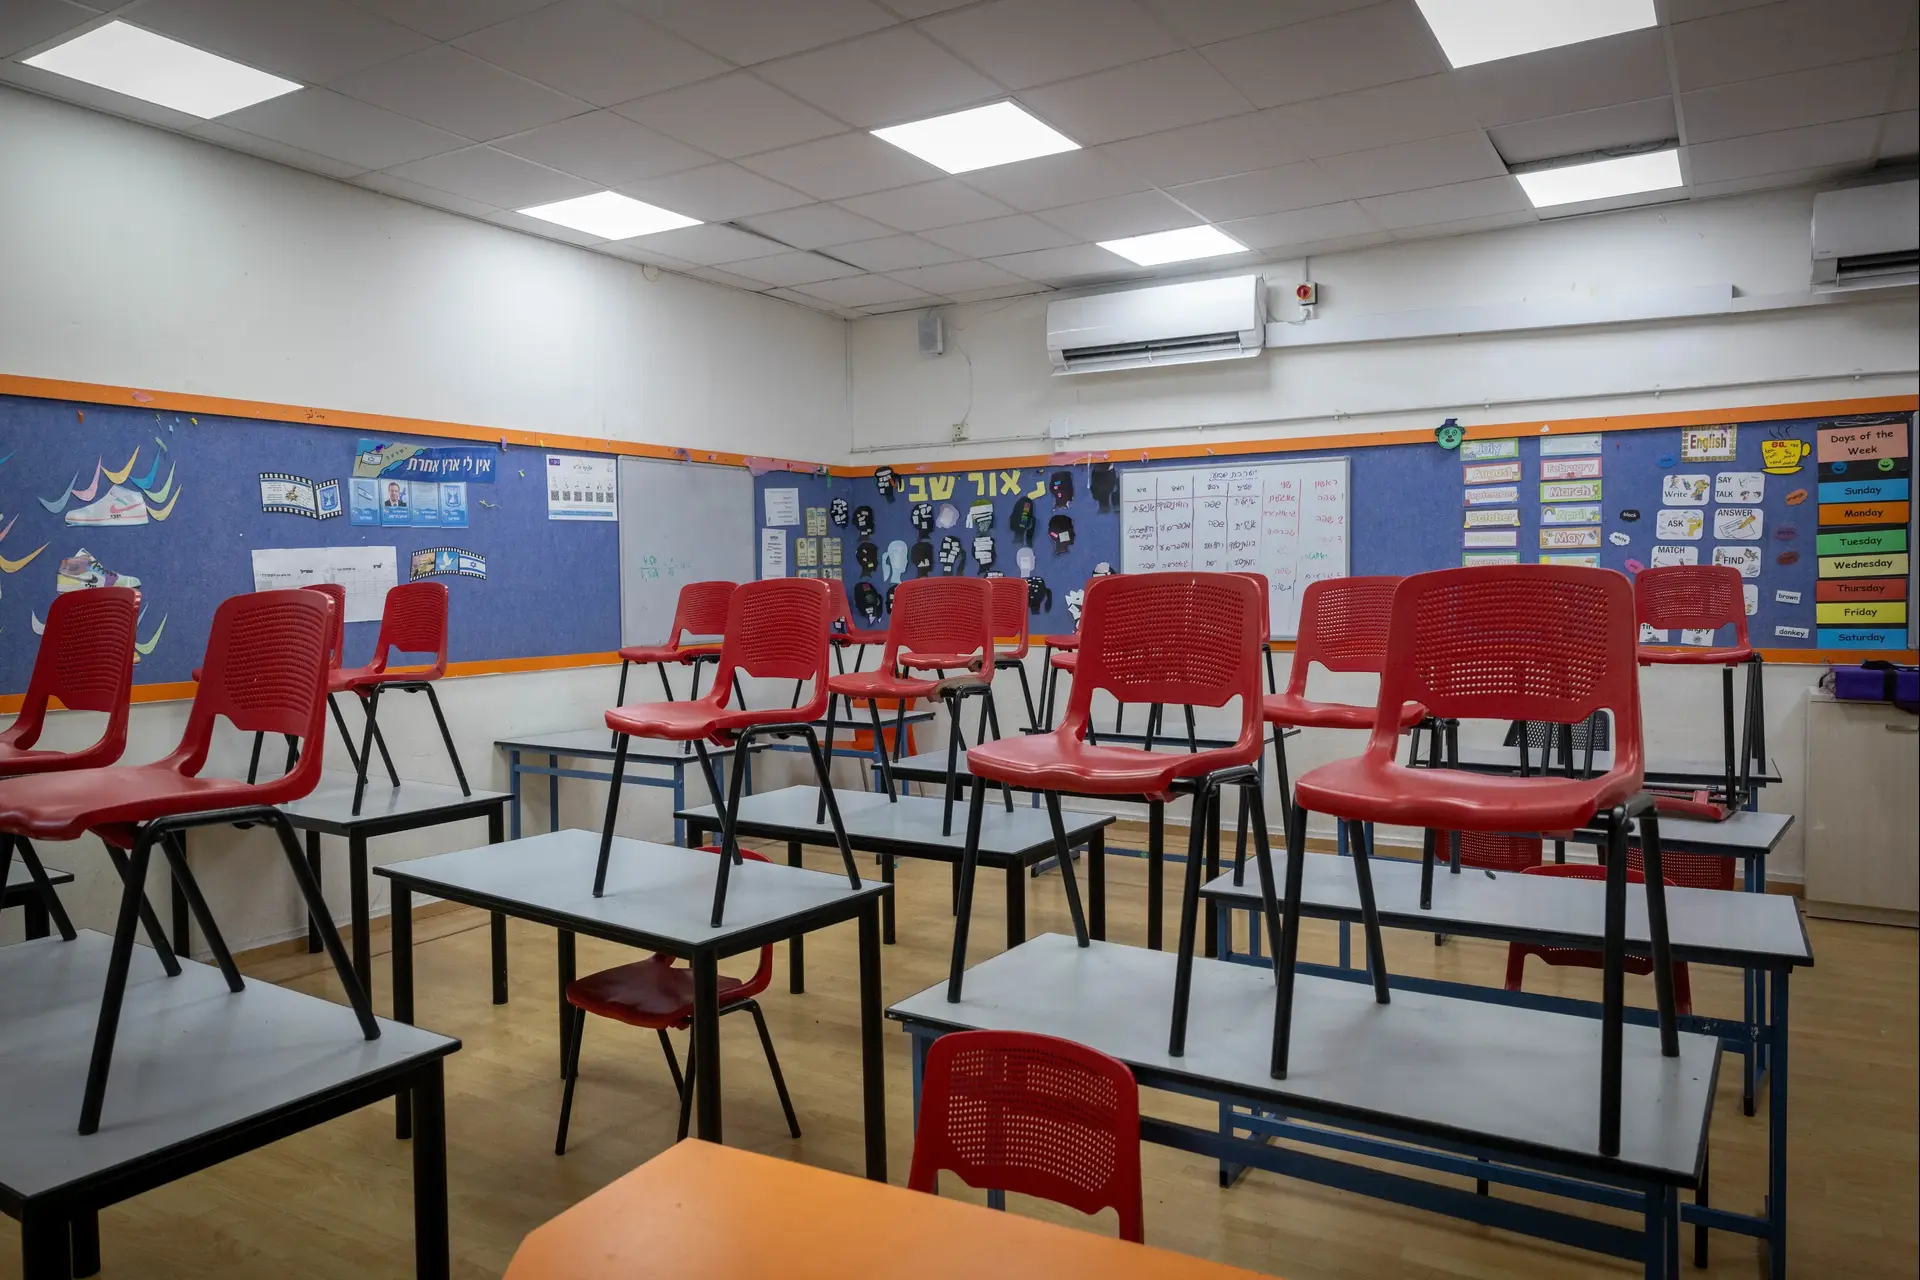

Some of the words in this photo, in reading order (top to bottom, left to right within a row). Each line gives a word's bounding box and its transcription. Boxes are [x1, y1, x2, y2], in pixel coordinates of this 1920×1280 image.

[1830, 433, 1856, 444] Days
[1860, 430, 1872, 440] of
[1876, 429, 1894, 439] the
[1689, 432, 1728, 453] English
[1478, 441, 1503, 457] July
[1847, 445, 1878, 456] Week
[408, 457, 441, 473] אחרת
[441, 457, 461, 475] ארץ
[463, 455, 473, 472] לי
[475, 456, 492, 475] אין
[1546, 463, 1596, 474] February
[1472, 466, 1513, 480] August
[1314, 479, 1338, 489] ראשון
[1717, 476, 1732, 484] SAY
[1549, 484, 1591, 499] March
[1664, 490, 1688, 499] Write
[1715, 490, 1735, 498] TALK
[1844, 486, 1882, 496] Sunday
[1466, 490, 1516, 503] September
[1203, 500, 1222, 509] שפה
[1468, 511, 1514, 523] October
[1554, 510, 1588, 523] April
[1717, 508, 1753, 517] ANSWER
[1843, 508, 1884, 519] Monday
[1207, 519, 1225, 528] שפה
[1316, 515, 1334, 524] שפה
[1337, 515, 1344, 525] 2
[1667, 519, 1684, 528] ASK
[1553, 532, 1586, 546] May
[1840, 537, 1882, 547] Tuesday
[1657, 546, 1686, 554] MATCH
[1723, 556, 1745, 565] FIND
[1834, 558, 1893, 570] Wednesday
[1837, 584, 1886, 593] Thursday
[1777, 593, 1799, 602] brown
[1843, 608, 1878, 618] Friday
[1778, 628, 1806, 637] donkey
[1838, 633, 1886, 643] Saturday
